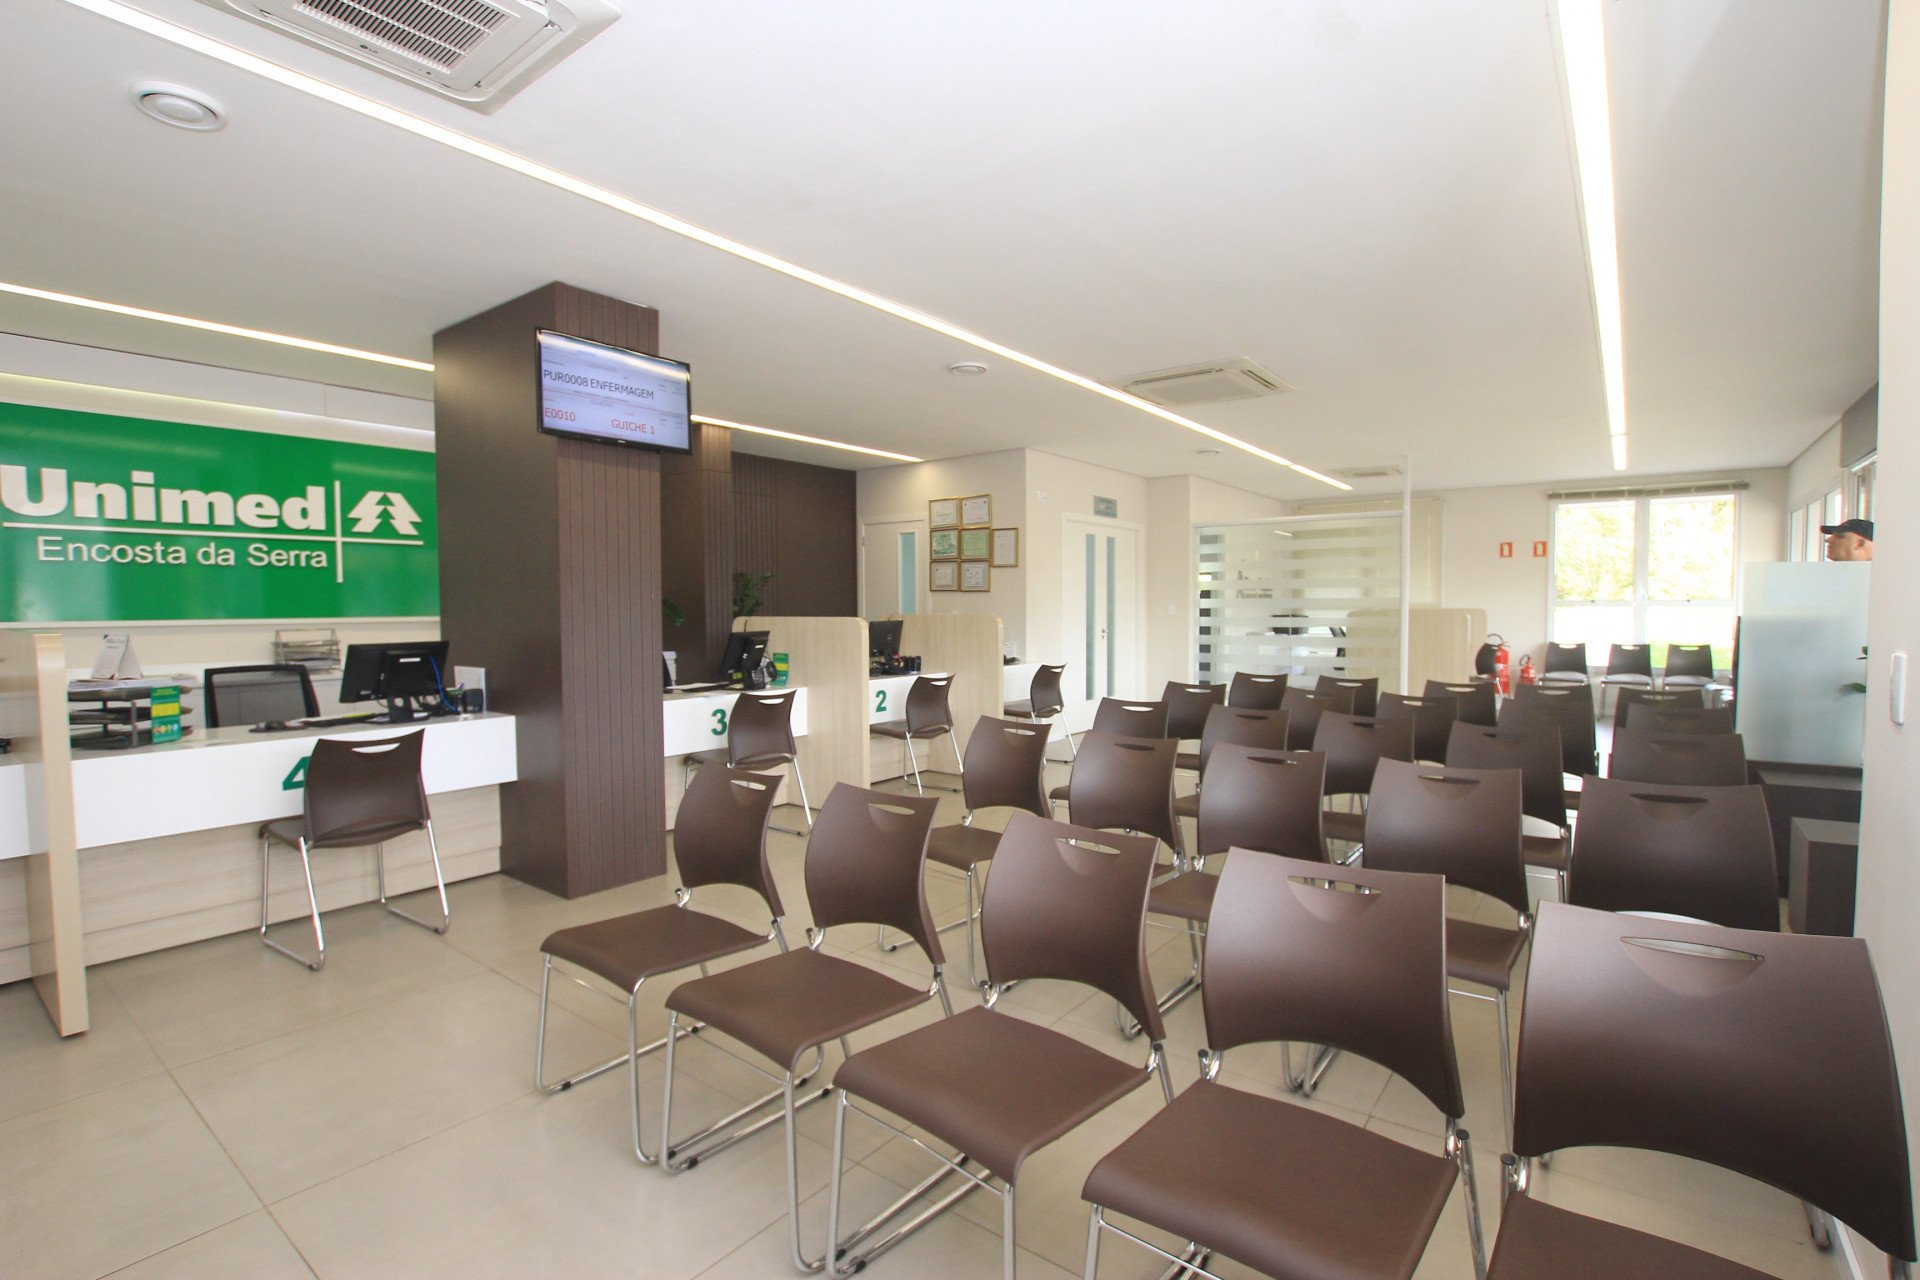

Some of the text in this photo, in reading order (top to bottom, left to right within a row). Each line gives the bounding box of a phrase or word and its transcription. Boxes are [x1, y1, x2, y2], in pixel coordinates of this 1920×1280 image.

[590, 378, 655, 400] ENFERMAGEM
[544, 407, 656, 435] E0010 GUICHE 1
[0, 464, 327, 531] Unimed
[37, 535, 328, 568] Encosta da Serra
[875, 689, 887, 713] 2
[711, 708, 728, 736] 3
[282, 756, 311, 791] 4
